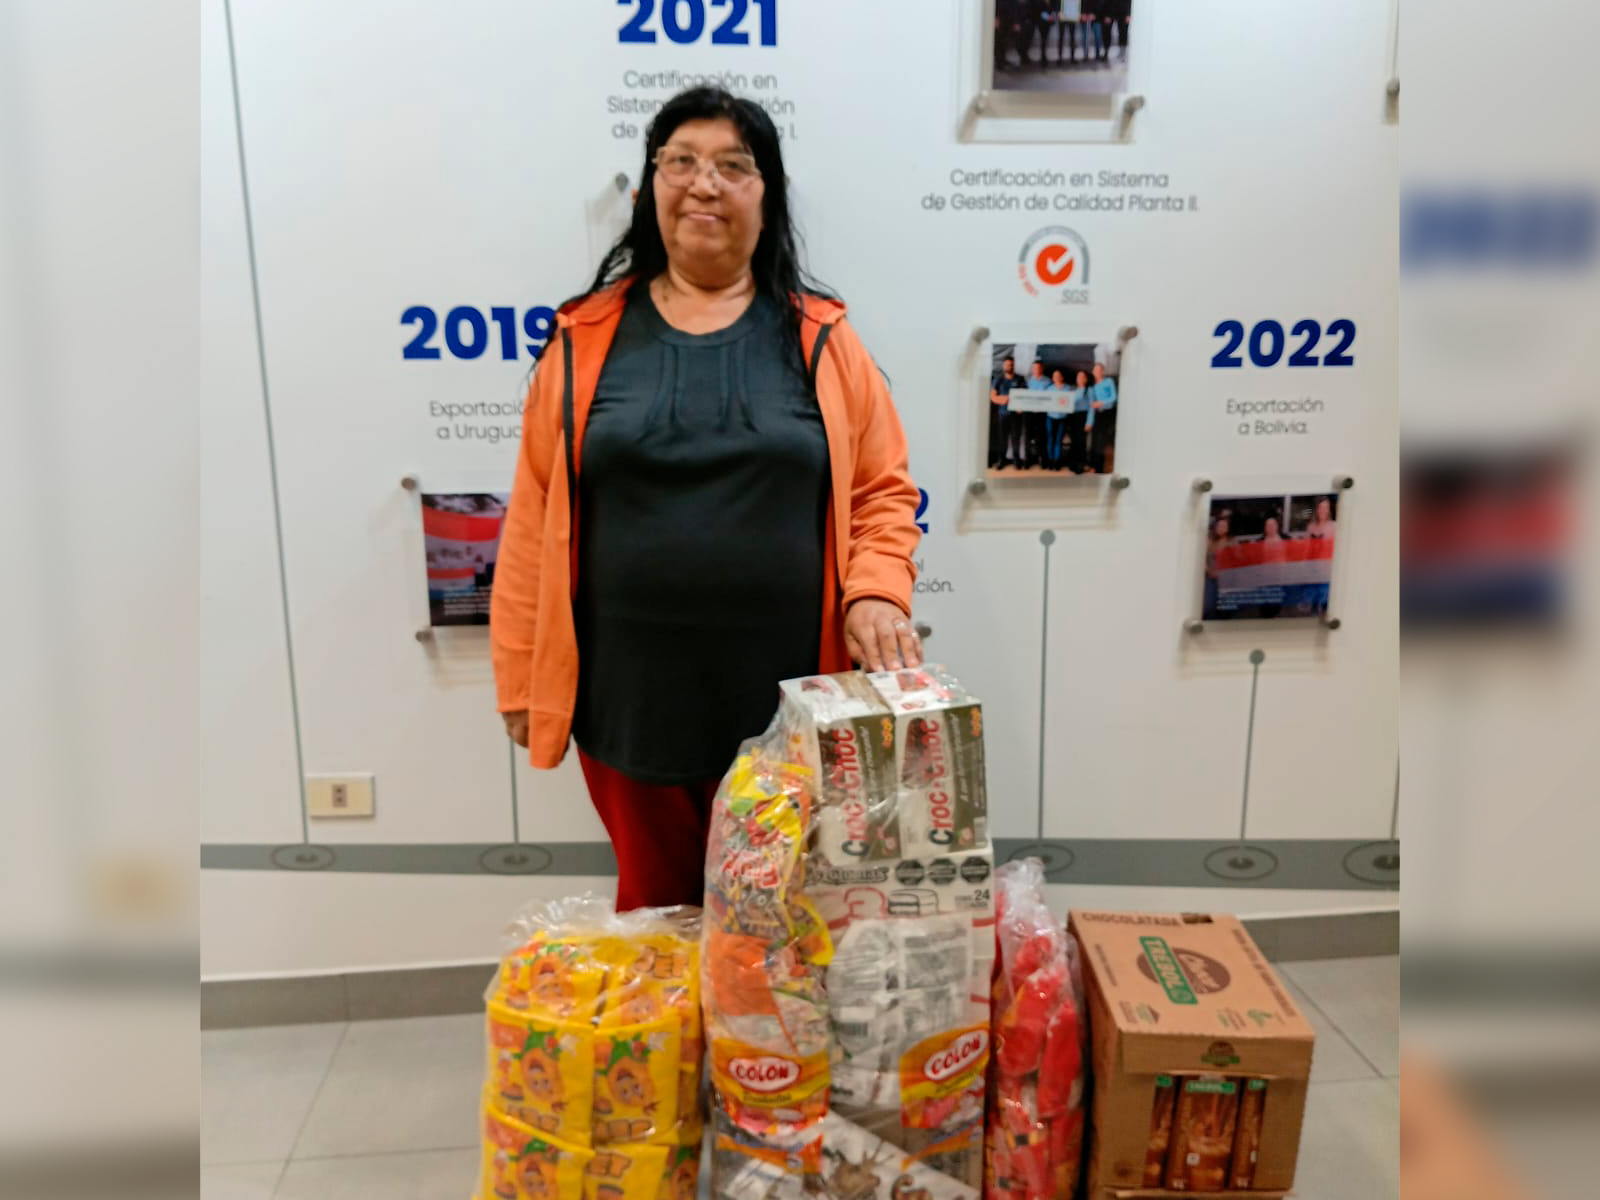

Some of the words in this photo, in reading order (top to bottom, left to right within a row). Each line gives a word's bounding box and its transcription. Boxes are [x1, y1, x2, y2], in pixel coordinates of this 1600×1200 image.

[617, 0, 778, 46] 2021
[752, 74, 778, 89] en
[612, 122, 638, 139] de
[949, 168, 1065, 187] Certificación
[1069, 173, 1094, 187] en
[1097, 169, 1169, 188] Sistema
[920, 193, 947, 210] de
[950, 193, 1020, 210] Gestión
[1023, 193, 1049, 211] de
[1053, 193, 1125, 212] Calidad
[1128, 194, 1185, 212] Planta
[400, 305, 557, 361] 2019
[1210, 319, 1357, 368] 2022
[1226, 398, 1325, 417] Exportación
[437, 426, 450, 439] a
[1237, 422, 1250, 435] a
[974, 889, 990, 901] 24
[931, 1034, 980, 1075] COLON
[735, 1064, 789, 1081] COLON
